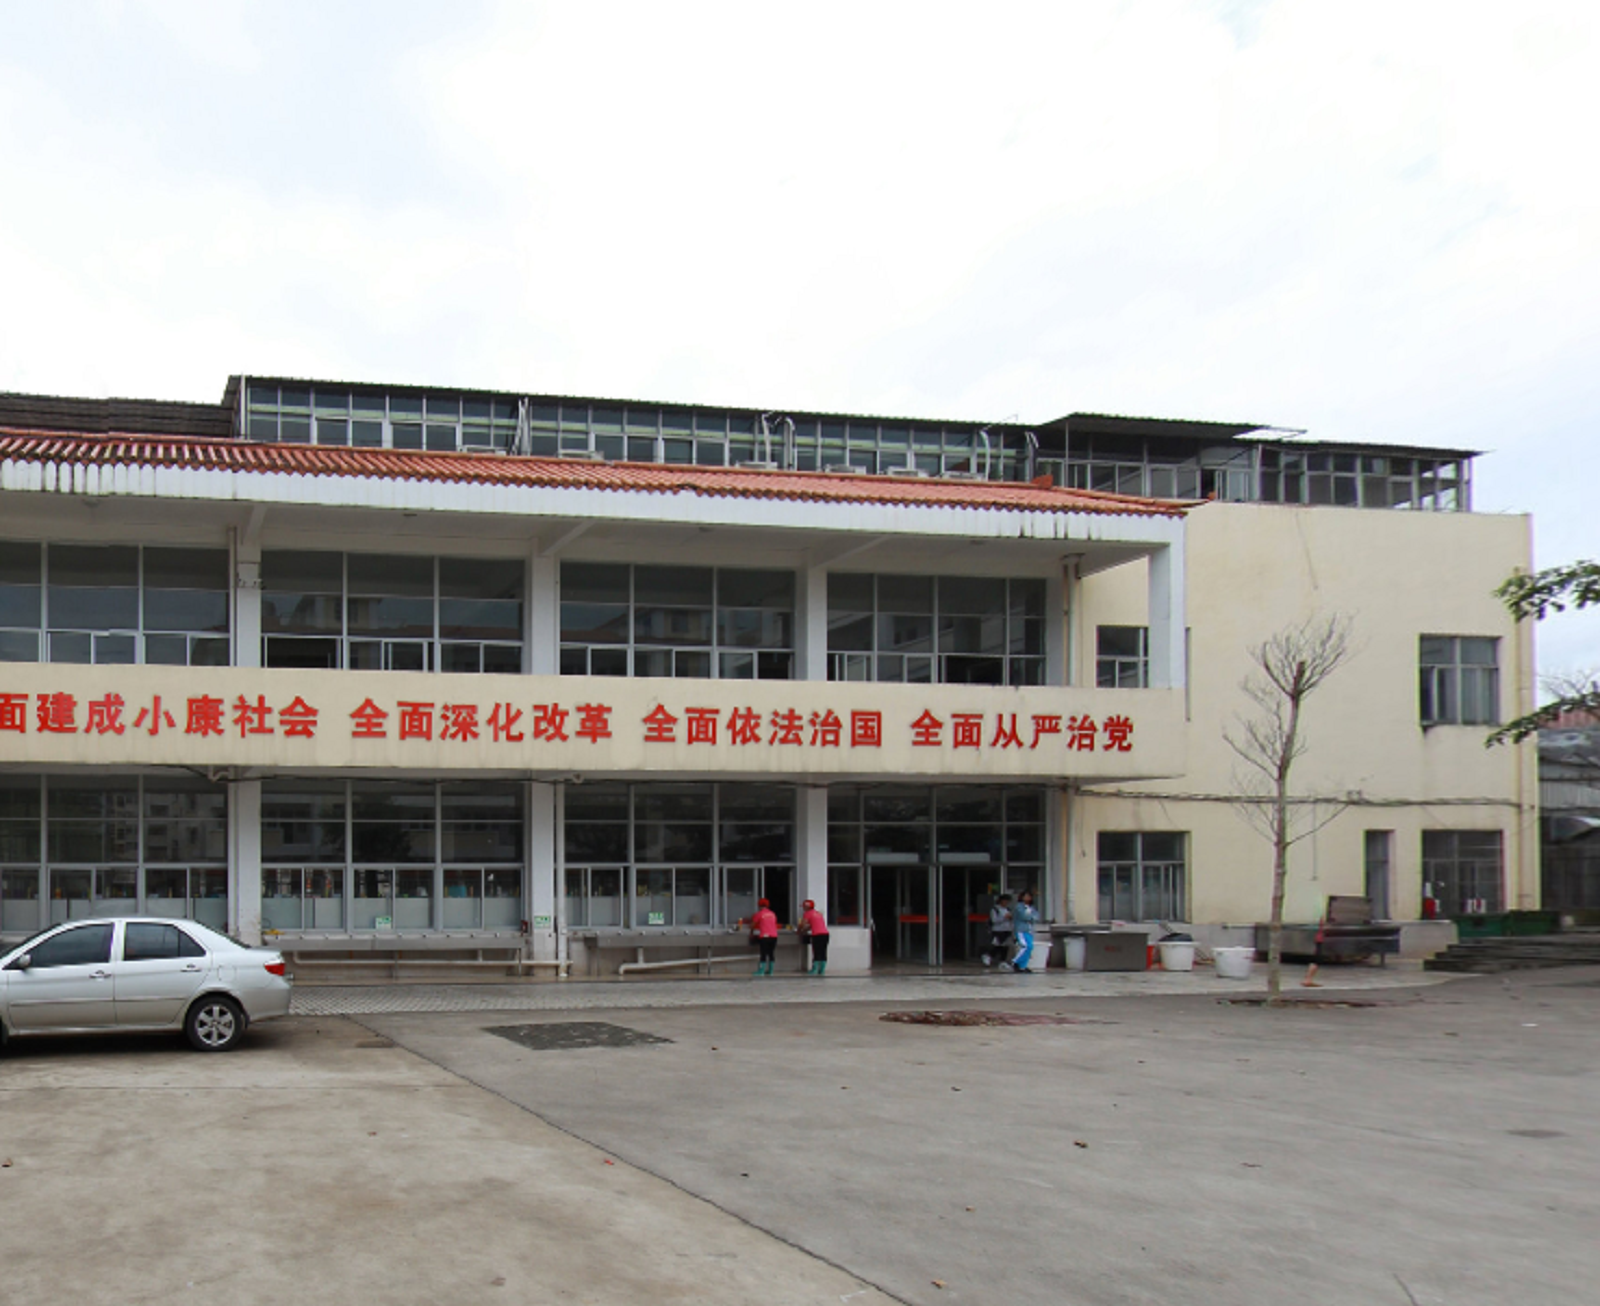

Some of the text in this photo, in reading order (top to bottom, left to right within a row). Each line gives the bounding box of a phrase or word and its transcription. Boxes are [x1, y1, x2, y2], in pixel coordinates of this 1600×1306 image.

[0, 692, 1133, 753] 面建成小康社会 全面深化改革 全面依法治国 全面从严治党
